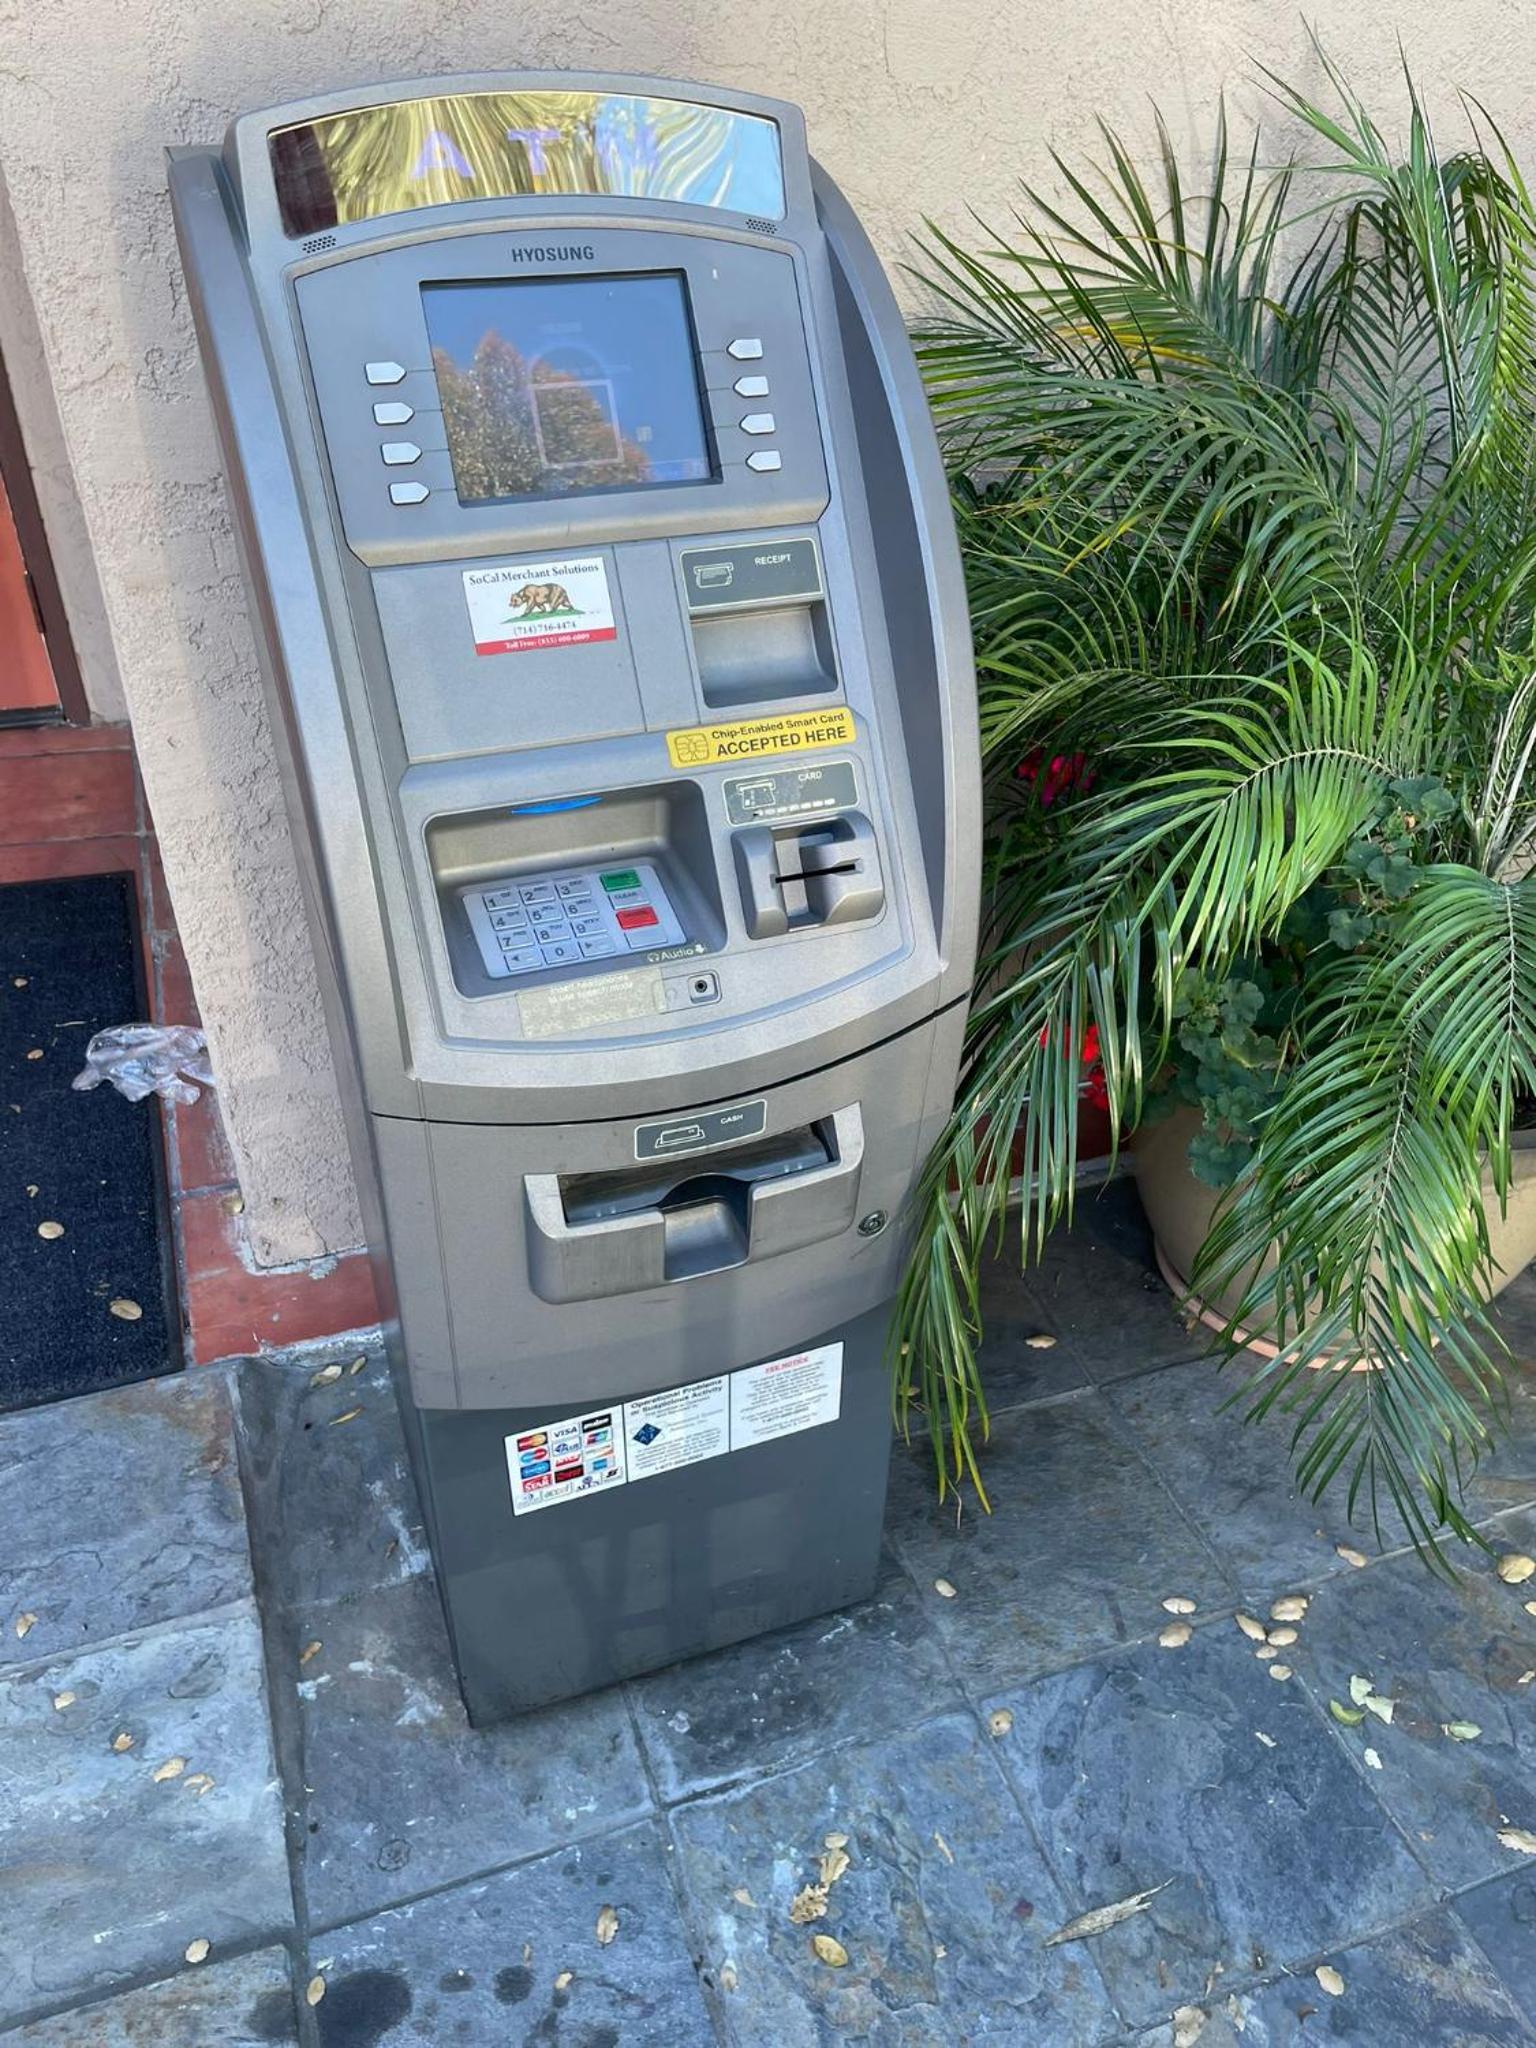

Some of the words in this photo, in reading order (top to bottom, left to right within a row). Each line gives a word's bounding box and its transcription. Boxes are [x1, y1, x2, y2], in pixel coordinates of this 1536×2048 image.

[511, 245, 595, 263] HYOSUNG
[754, 553, 792, 566] RECEIPT
[469, 573, 500, 586] SoCal
[502, 569, 550, 583] Merchant
[552, 563, 600, 577] Solutions
[711, 721, 785, 741] Chip-Enabled
[786, 715, 819, 730] Smart
[820, 711, 845, 724] Card
[716, 733, 802, 757] ACCEPTED
[805, 725, 848, 743] HERE
[797, 770, 823, 782] CARD
[525, 890, 536, 901] 2
[561, 885, 571, 896] 3
[488, 898, 498, 908] 1
[569, 904, 579, 915] 6
[533, 911, 543, 922] 5
[496, 917, 506, 928] 4
[576, 923, 586, 934] 9
[540, 930, 550, 940] 8
[502, 936, 512, 947] 7
[555, 947, 565, 957] 0
[660, 946, 694, 961] Audio
[720, 1113, 744, 1125] CASH
[553, 1426, 578, 1439] VISA
[524, 1477, 550, 1492] STAR
